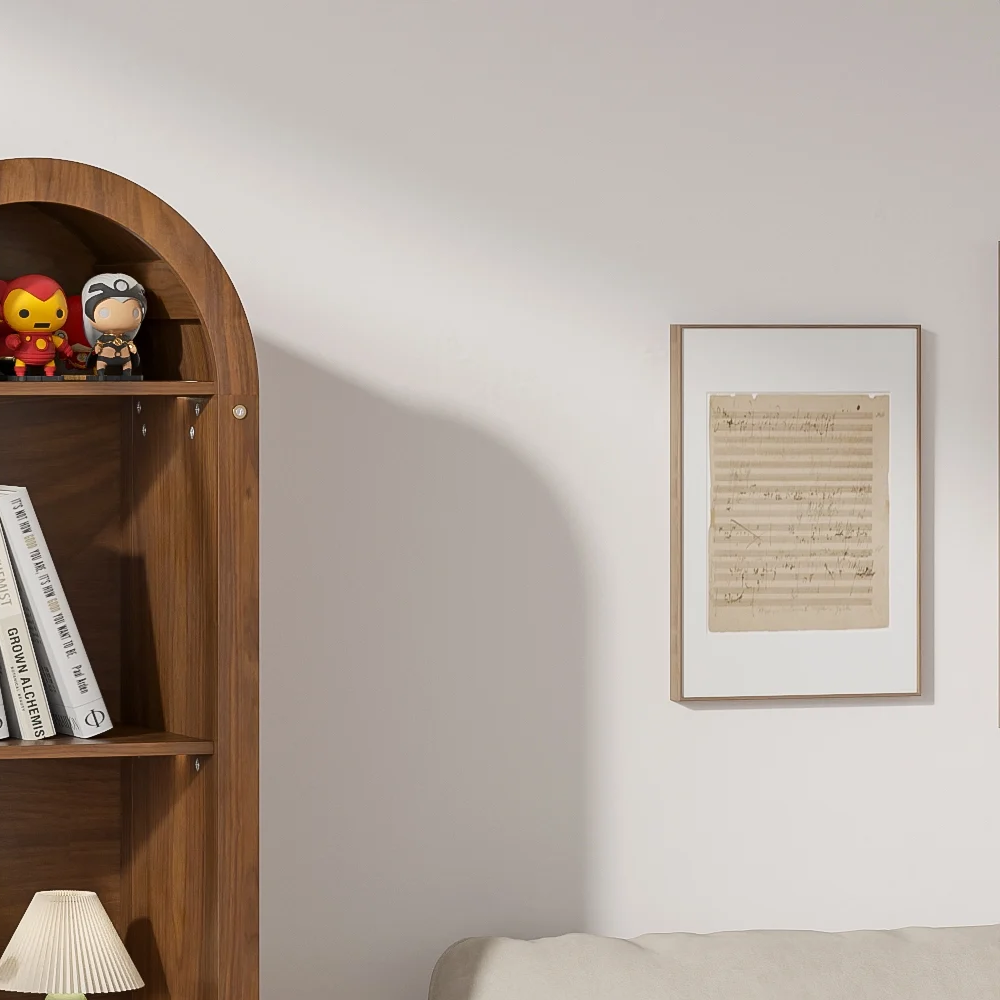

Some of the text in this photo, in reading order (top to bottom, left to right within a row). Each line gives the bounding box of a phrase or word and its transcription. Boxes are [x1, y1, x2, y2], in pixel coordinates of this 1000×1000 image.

[15, 509, 28, 521] NOT
[19, 521, 32, 534] HOW
[30, 548, 42, 561] YOU
[42, 584, 56, 598] HOW
[53, 612, 65, 624] YOU
[57, 624, 71, 640] WANT
[63, 640, 74, 649] TO
[7, 627, 46, 739] GROWN ALCHEMIS
[72, 664, 89, 694] Paul Arden
